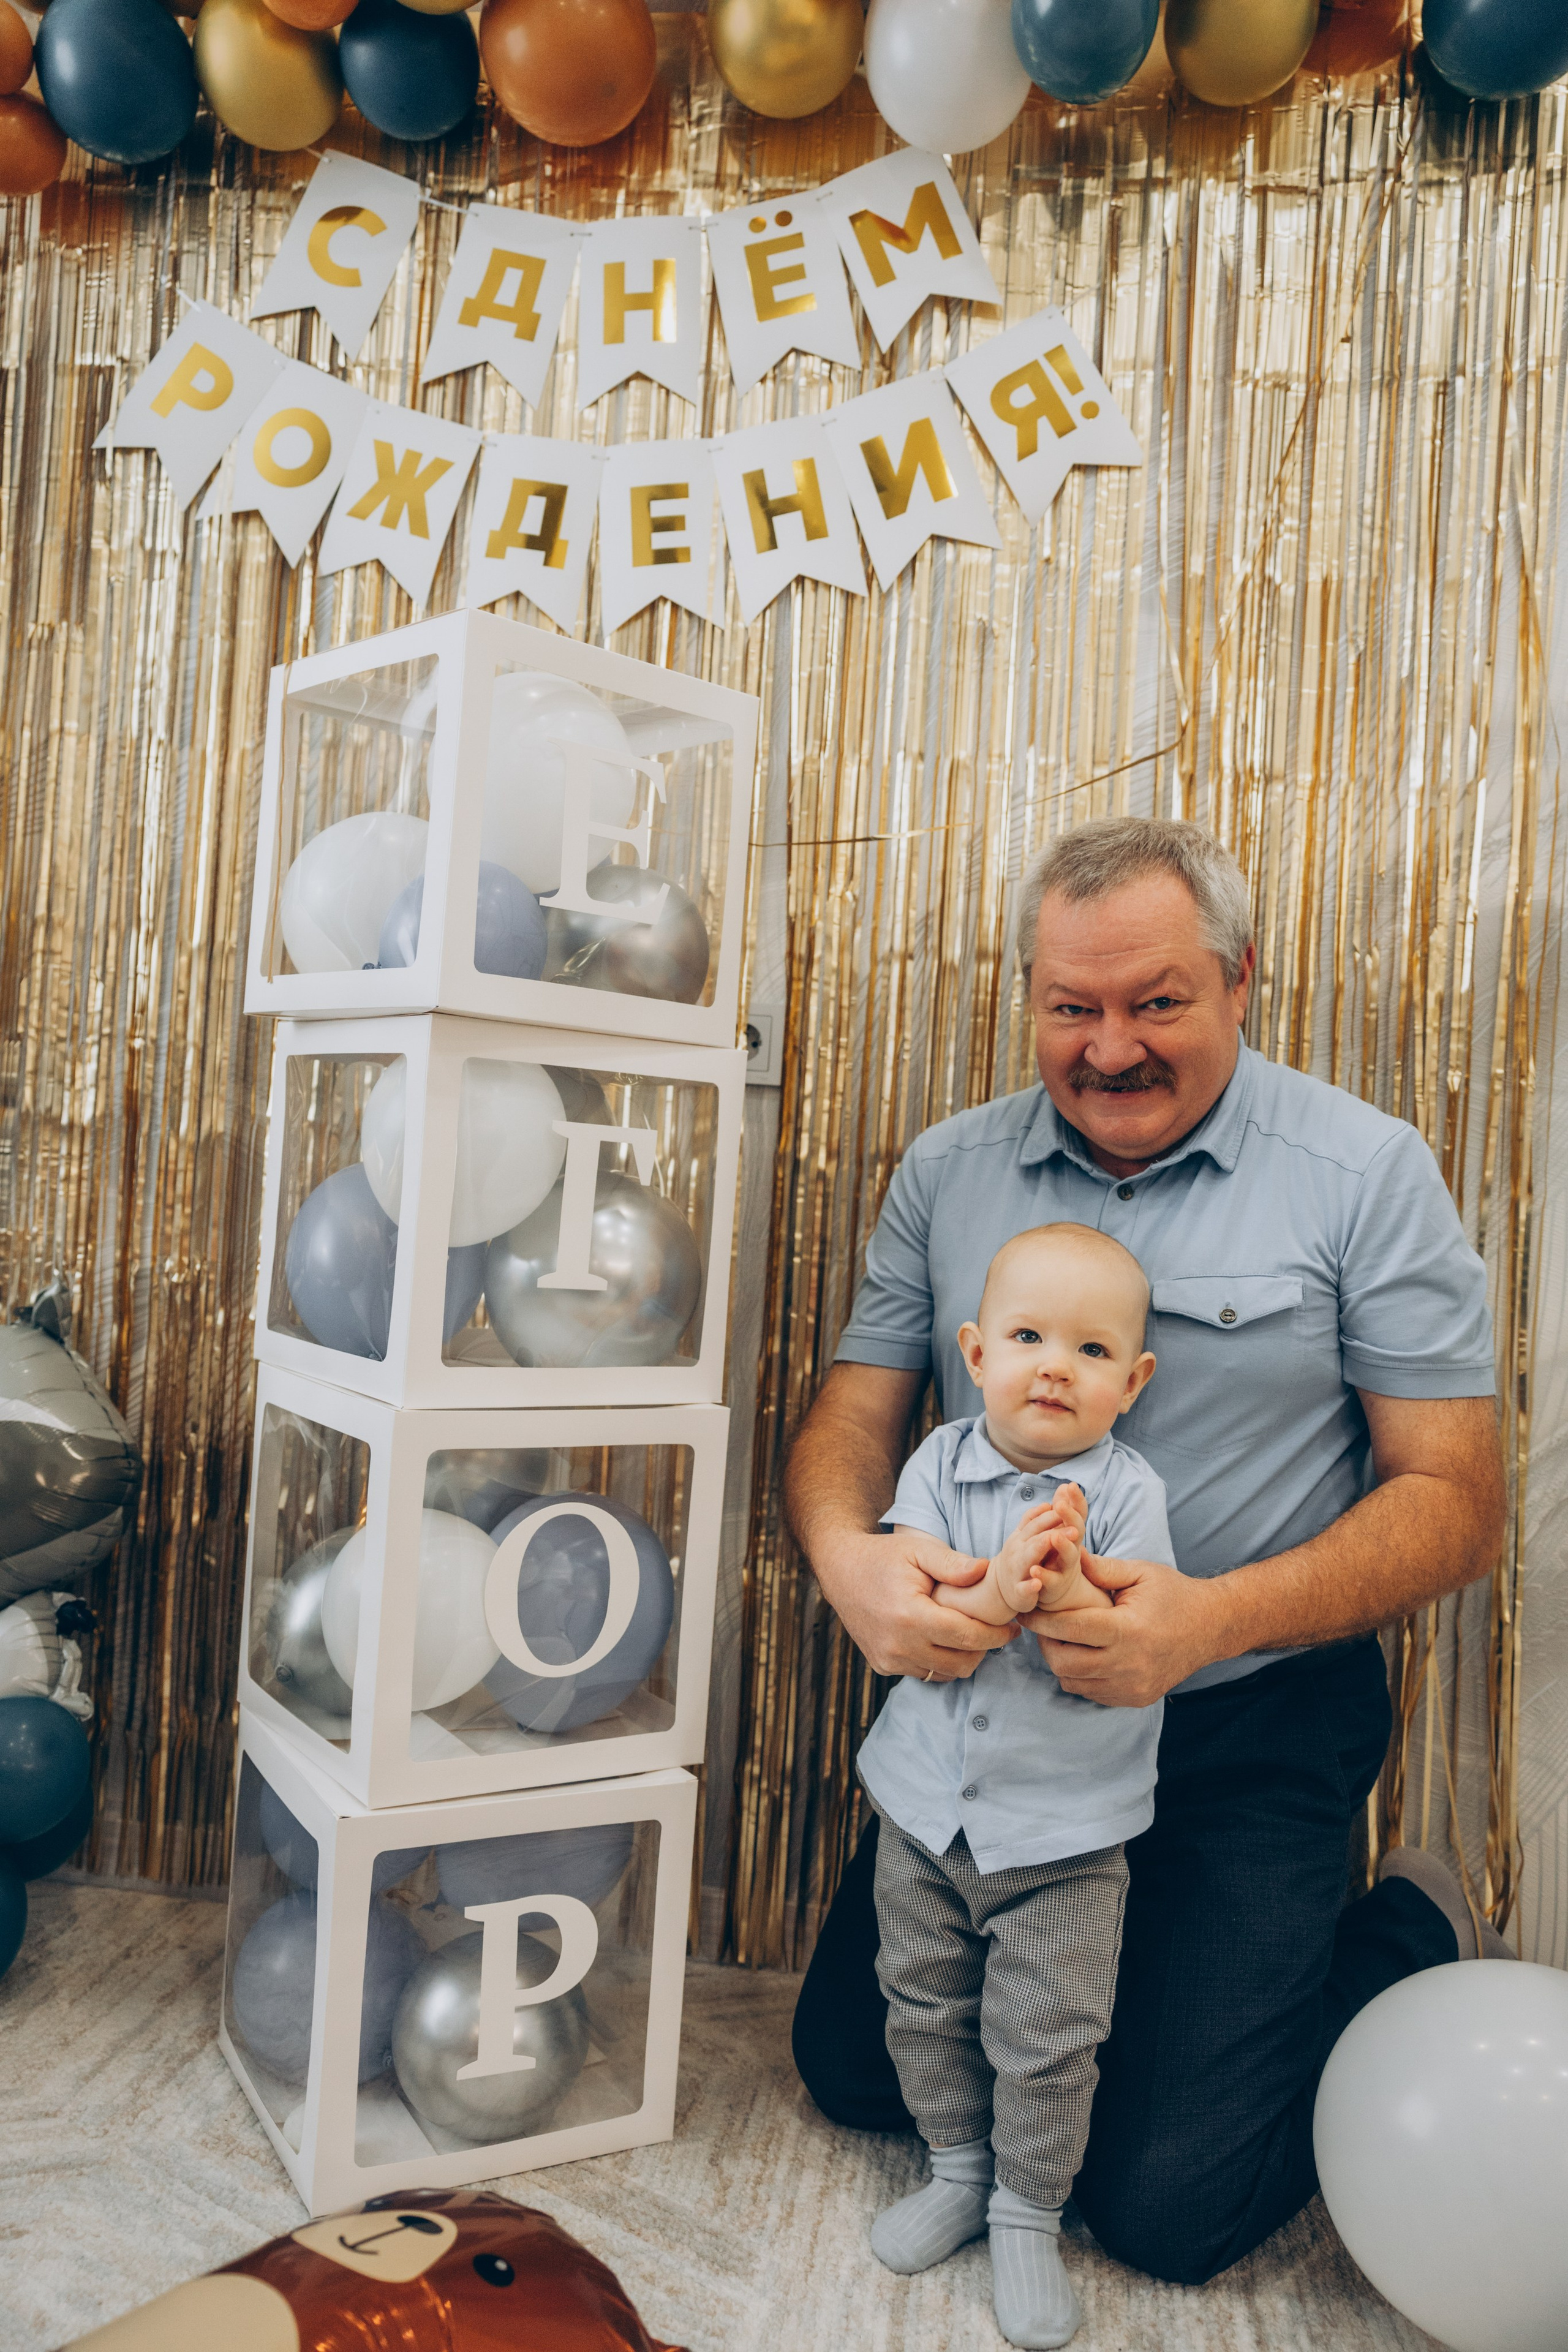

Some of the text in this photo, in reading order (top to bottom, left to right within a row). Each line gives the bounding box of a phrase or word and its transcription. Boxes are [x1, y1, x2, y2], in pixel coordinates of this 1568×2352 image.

[307, 181, 963, 342] С ДНЁМ
[149, 341, 1100, 570] РОЖДЕНИЯ!
